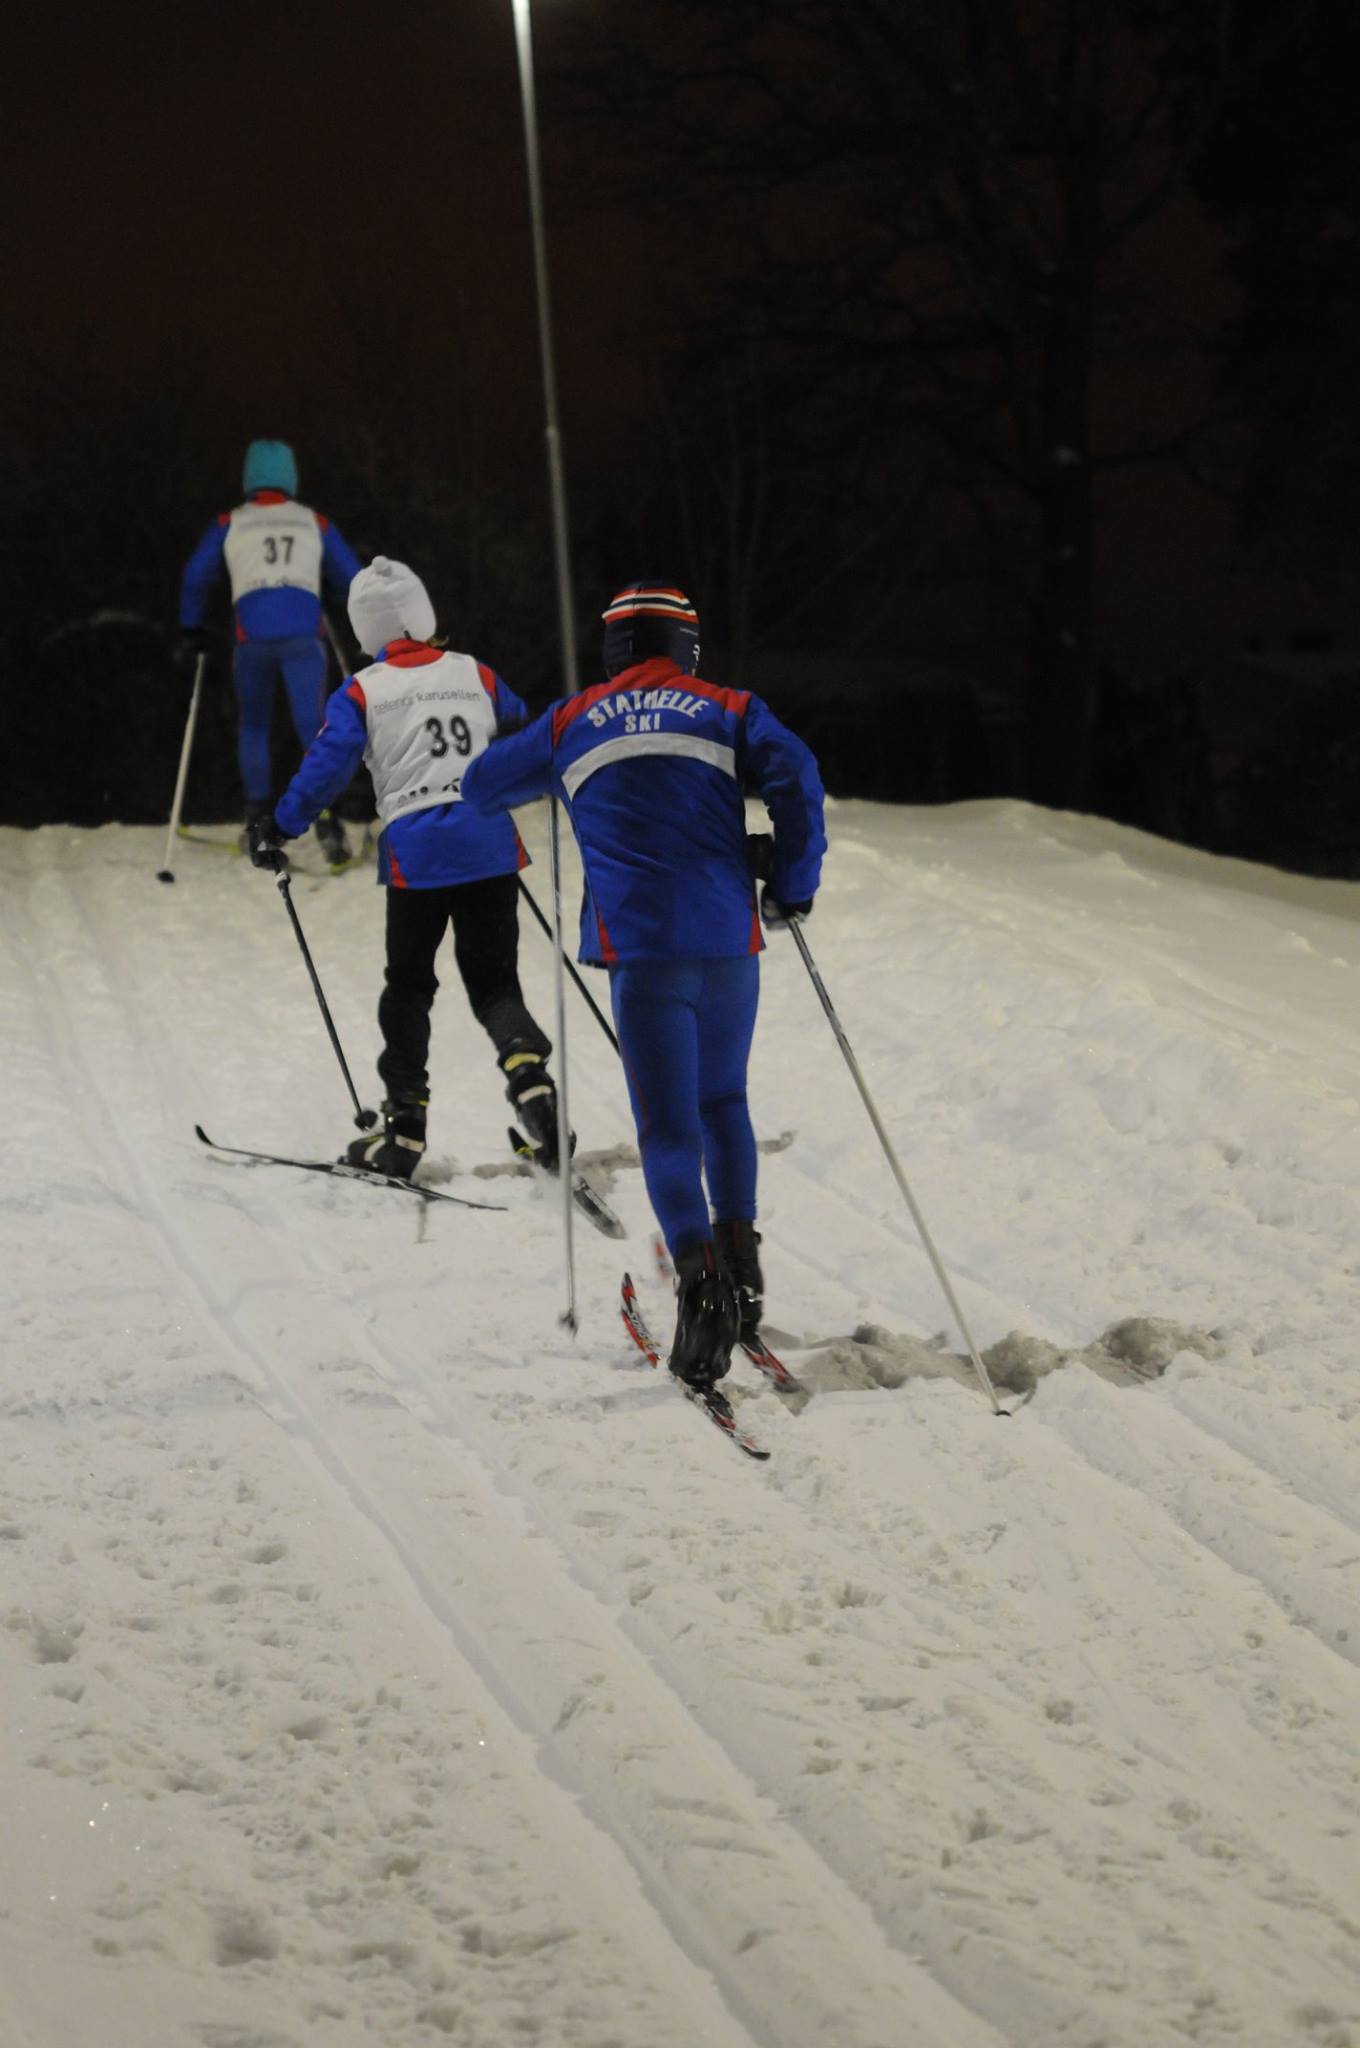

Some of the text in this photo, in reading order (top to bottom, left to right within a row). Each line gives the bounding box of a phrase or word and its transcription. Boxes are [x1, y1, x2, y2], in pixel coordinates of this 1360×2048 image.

[263, 536, 295, 565] 37
[426, 715, 472, 758] 39
[624, 712, 661, 733] SKI
